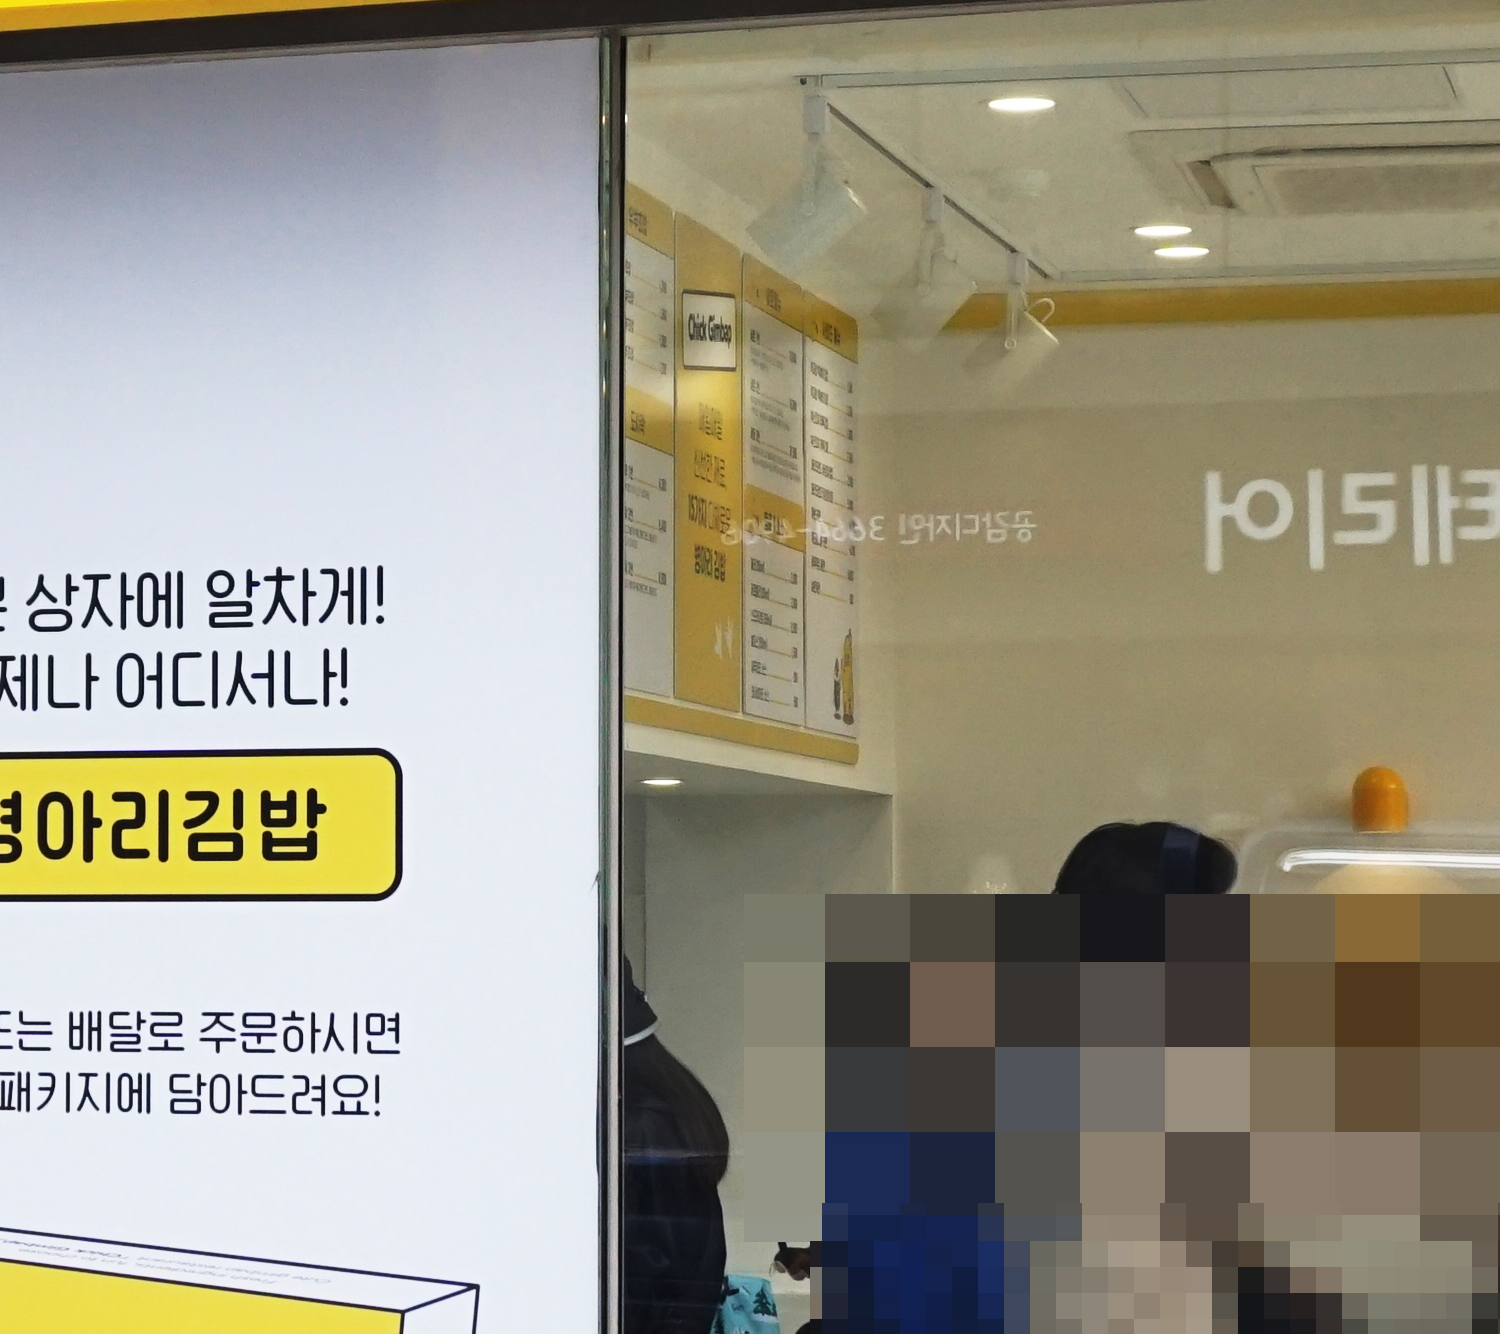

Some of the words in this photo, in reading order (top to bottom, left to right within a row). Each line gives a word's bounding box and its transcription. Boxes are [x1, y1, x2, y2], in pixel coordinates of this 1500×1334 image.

[688, 313, 707, 342] Chick
[708, 313, 732, 349] Gimbap
[24, 569, 186, 634] 상자에
[205, 564, 387, 630] 알차게!
[115, 646, 351, 711] 어디서나!
[67, 1009, 187, 1054] 배달로
[198, 1009, 403, 1056] 주문하시면
[168, 1072, 382, 1118] 담아드려요!
